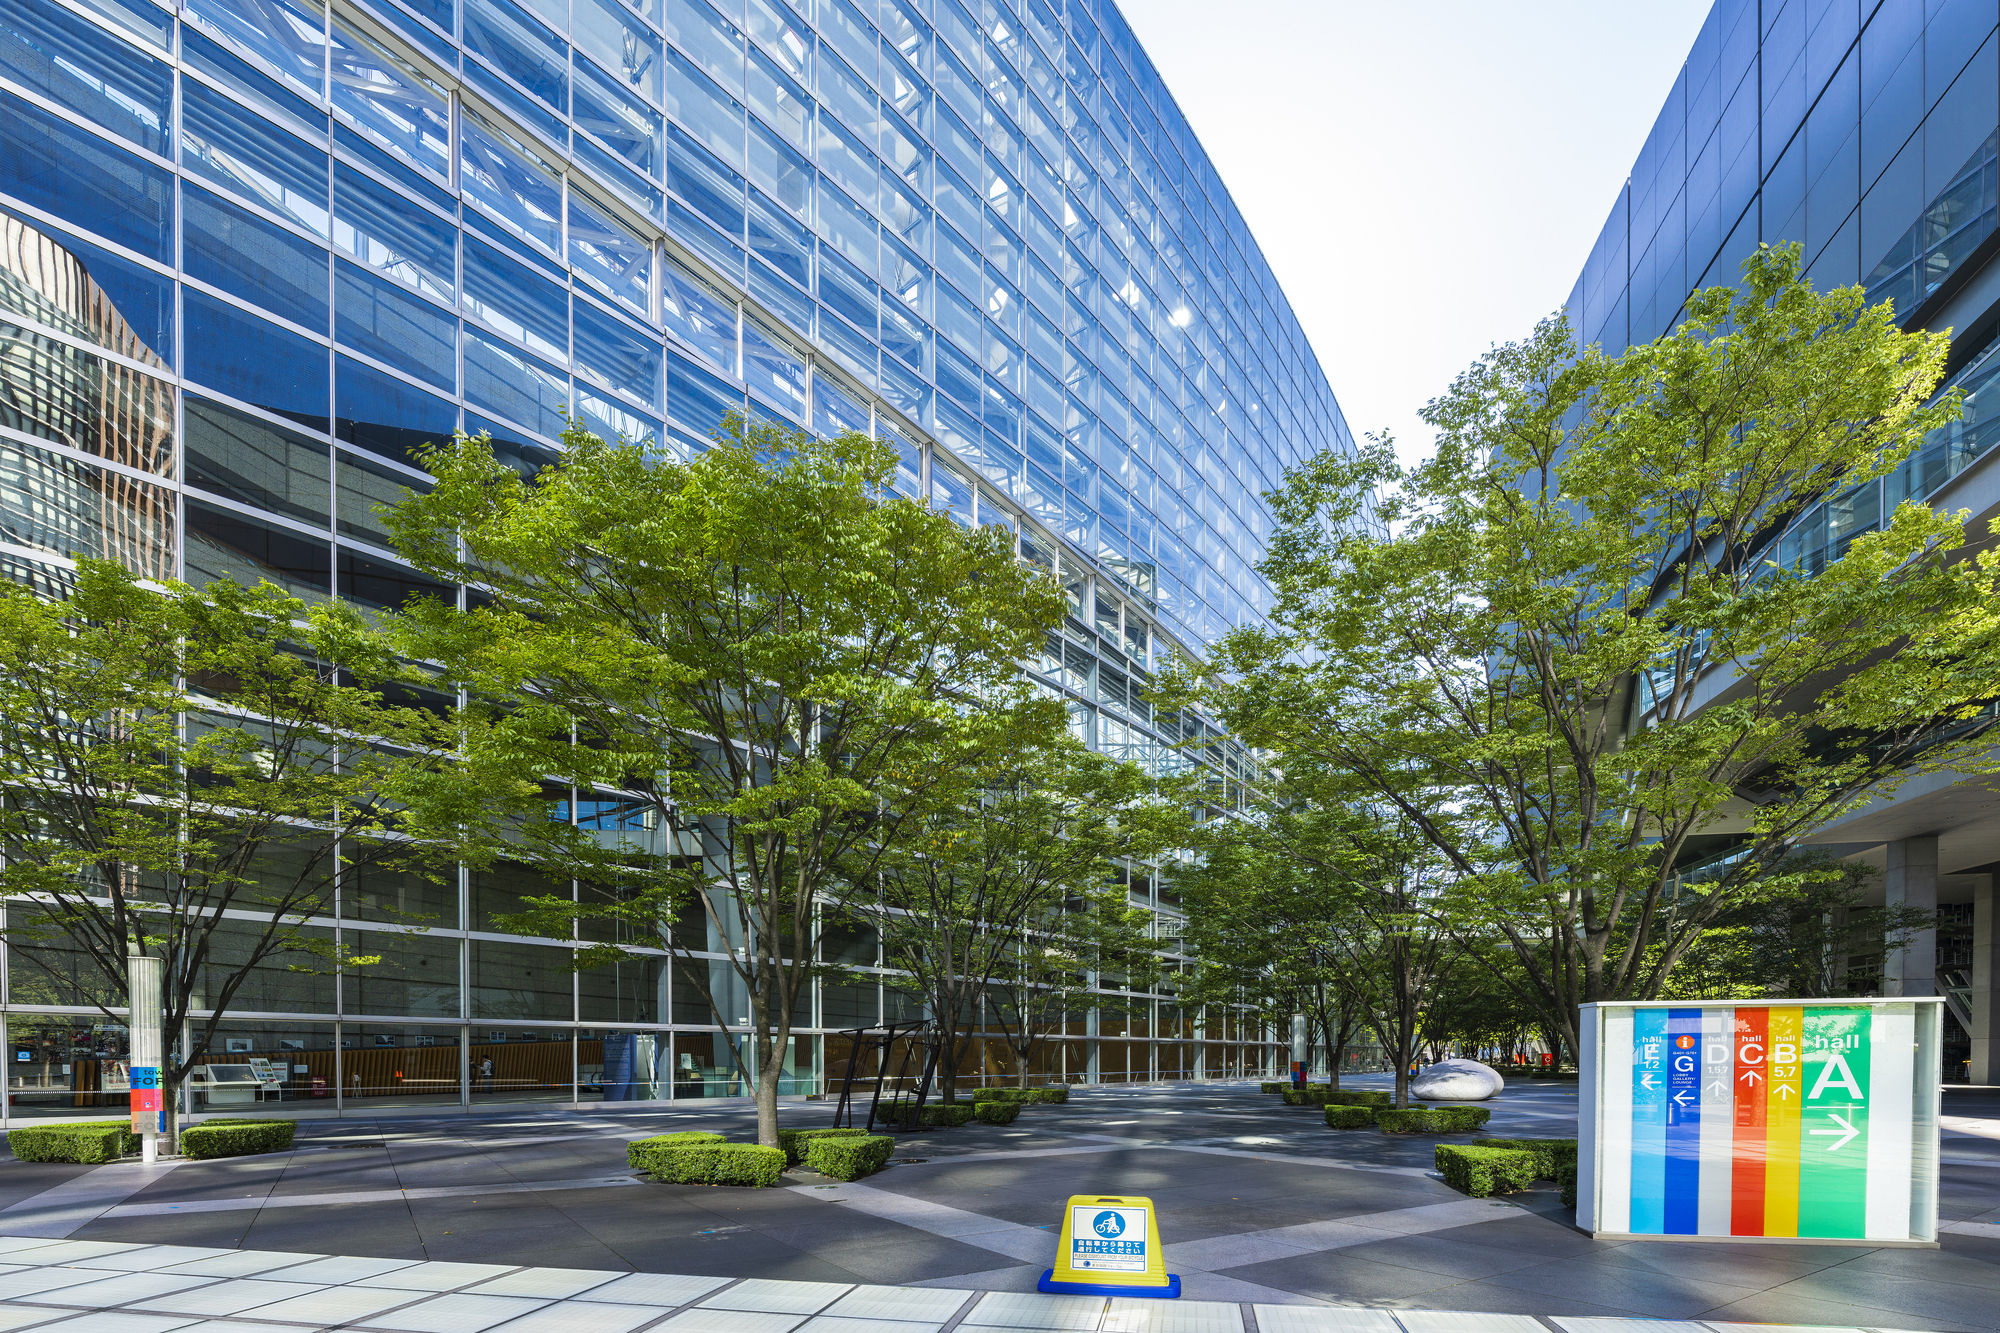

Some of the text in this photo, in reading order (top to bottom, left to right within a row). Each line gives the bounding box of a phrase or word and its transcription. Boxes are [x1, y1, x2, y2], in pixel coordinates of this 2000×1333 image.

[1815, 1034, 1859, 1049] hall
[1644, 1043, 1660, 1060] E
[1707, 1044, 1730, 1064] D
[1739, 1043, 1764, 1065] C
[1774, 1043, 1797, 1064] B
[1643, 1061, 1660, 1070] 1,2
[1674, 1055, 1694, 1072] G
[1707, 1066, 1729, 1075] 1,5,7
[1774, 1066, 1796, 1078] 5,7
[1807, 1054, 1864, 1100] A
[1077, 1246, 1140, 1254] 通行してください
[1078, 1240, 1140, 1248] 自転車から降りて
